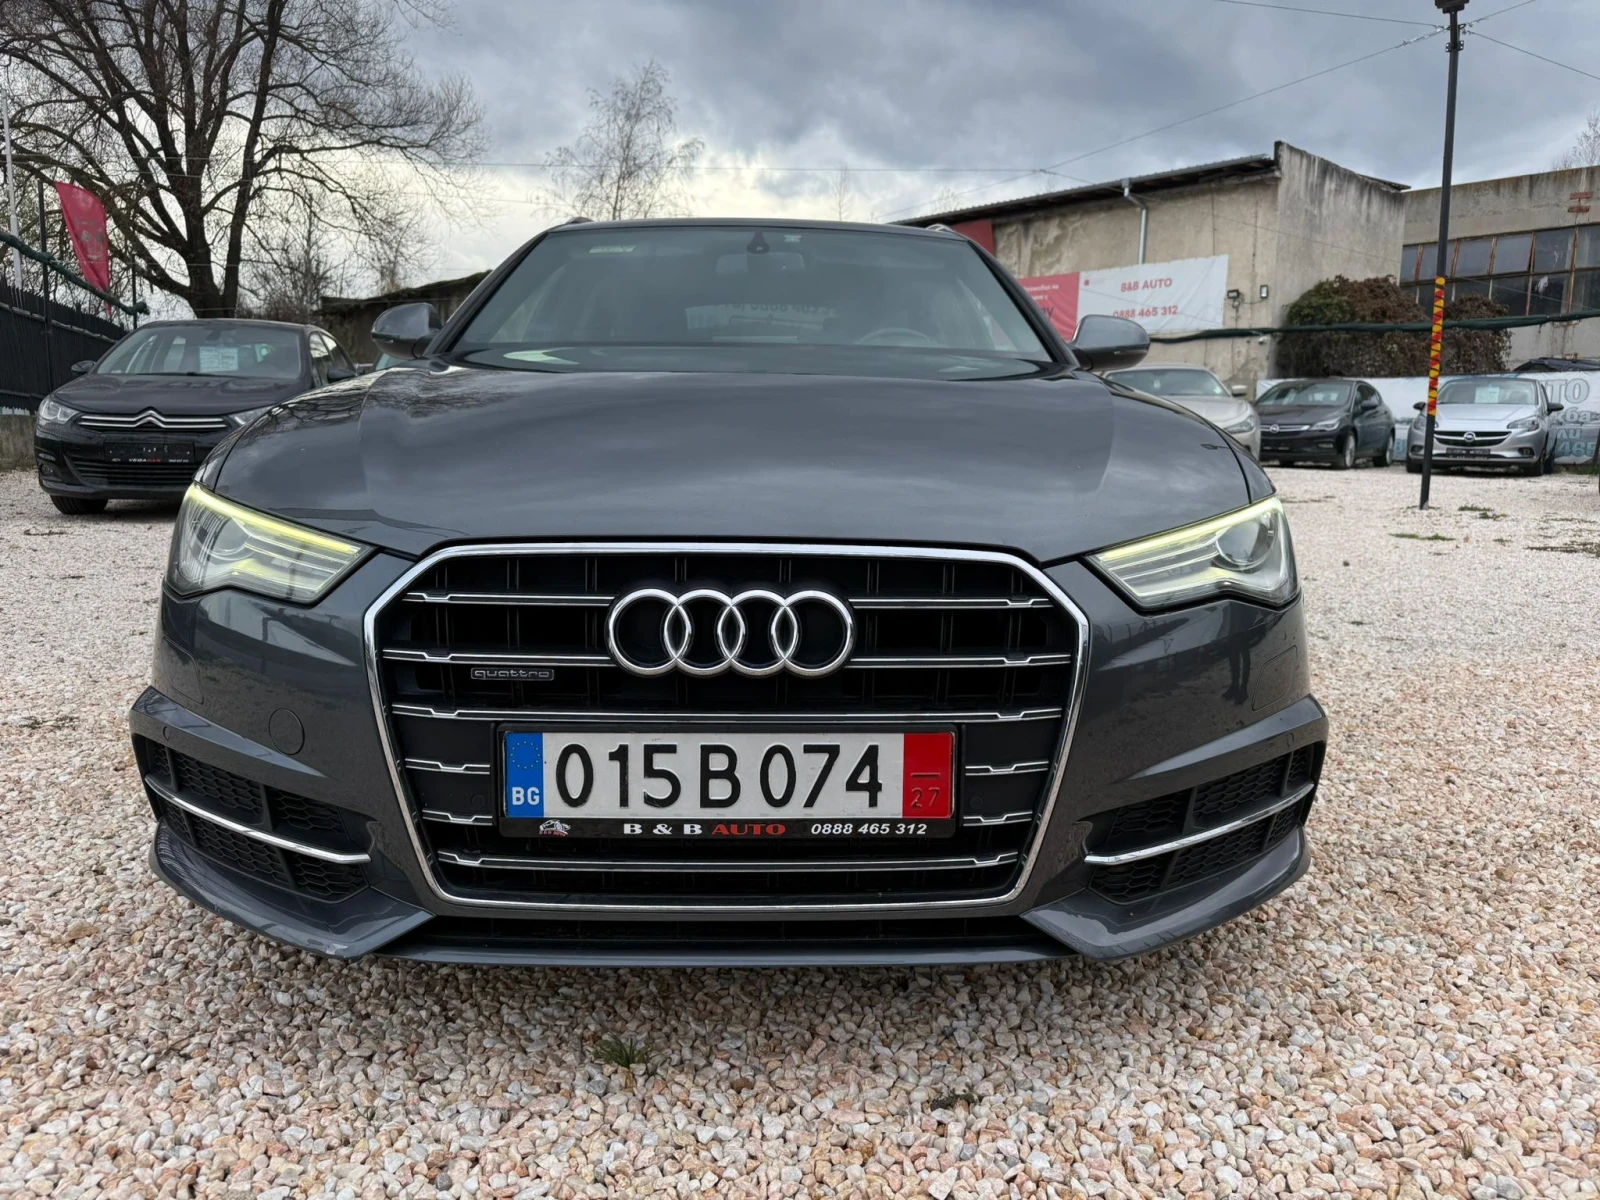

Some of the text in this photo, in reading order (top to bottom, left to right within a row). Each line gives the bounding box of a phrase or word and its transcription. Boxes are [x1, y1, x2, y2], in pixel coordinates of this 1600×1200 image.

[1120, 277, 1173, 293] B&B AUTO
[1112, 305, 1179, 319] 0888 465 312
[474, 669, 550, 679] quattro
[511, 786, 540, 806] BG
[911, 786, 940, 809] 27
[623, 823, 927, 835] B & B AUTO 0888 465 312
